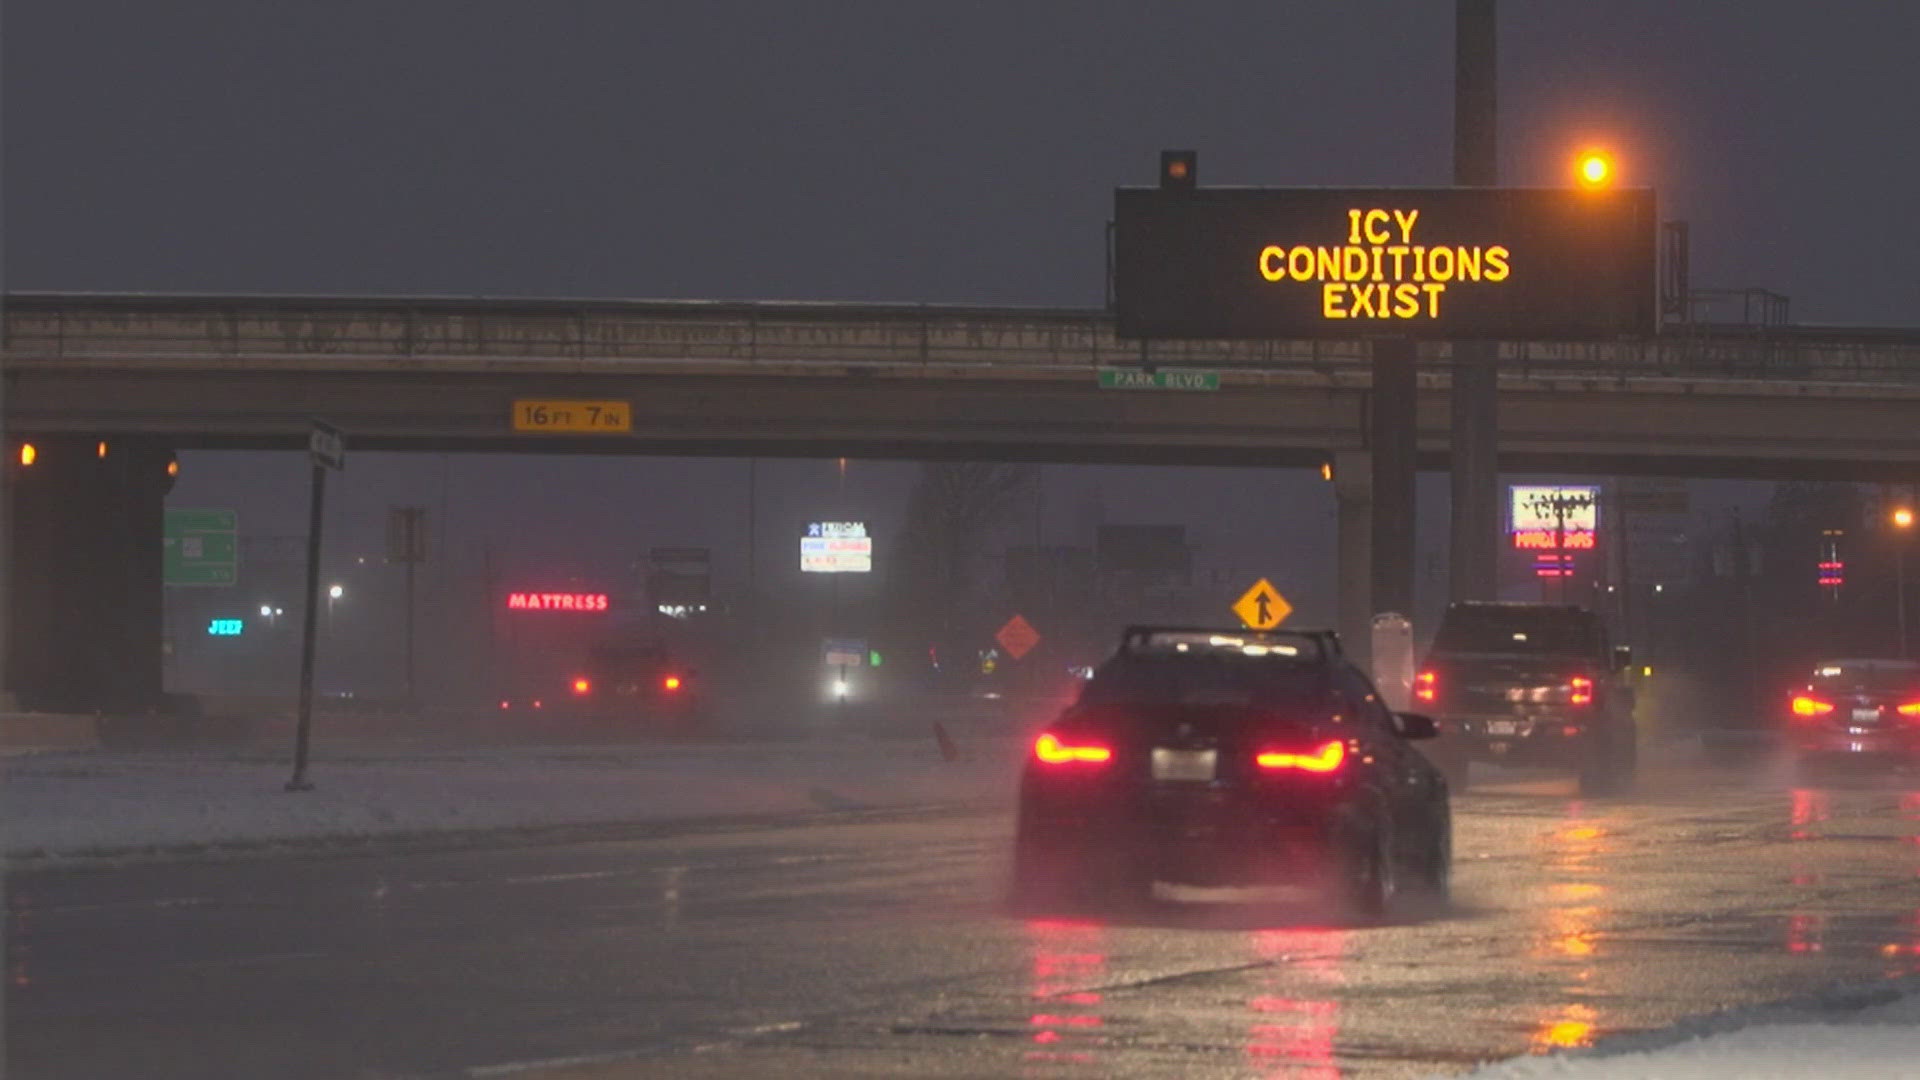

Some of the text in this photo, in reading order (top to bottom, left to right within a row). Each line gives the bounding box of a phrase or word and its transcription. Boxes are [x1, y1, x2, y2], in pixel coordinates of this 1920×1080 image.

[1349, 209, 1418, 244] ICY
[1259, 246, 1510, 281] CONDITIONS
[1323, 283, 1445, 318] EXIST
[1114, 373, 1155, 386] PARK
[525, 405, 620, 426] 16 FT 7 IN
[508, 592, 608, 610] MATTRESS
